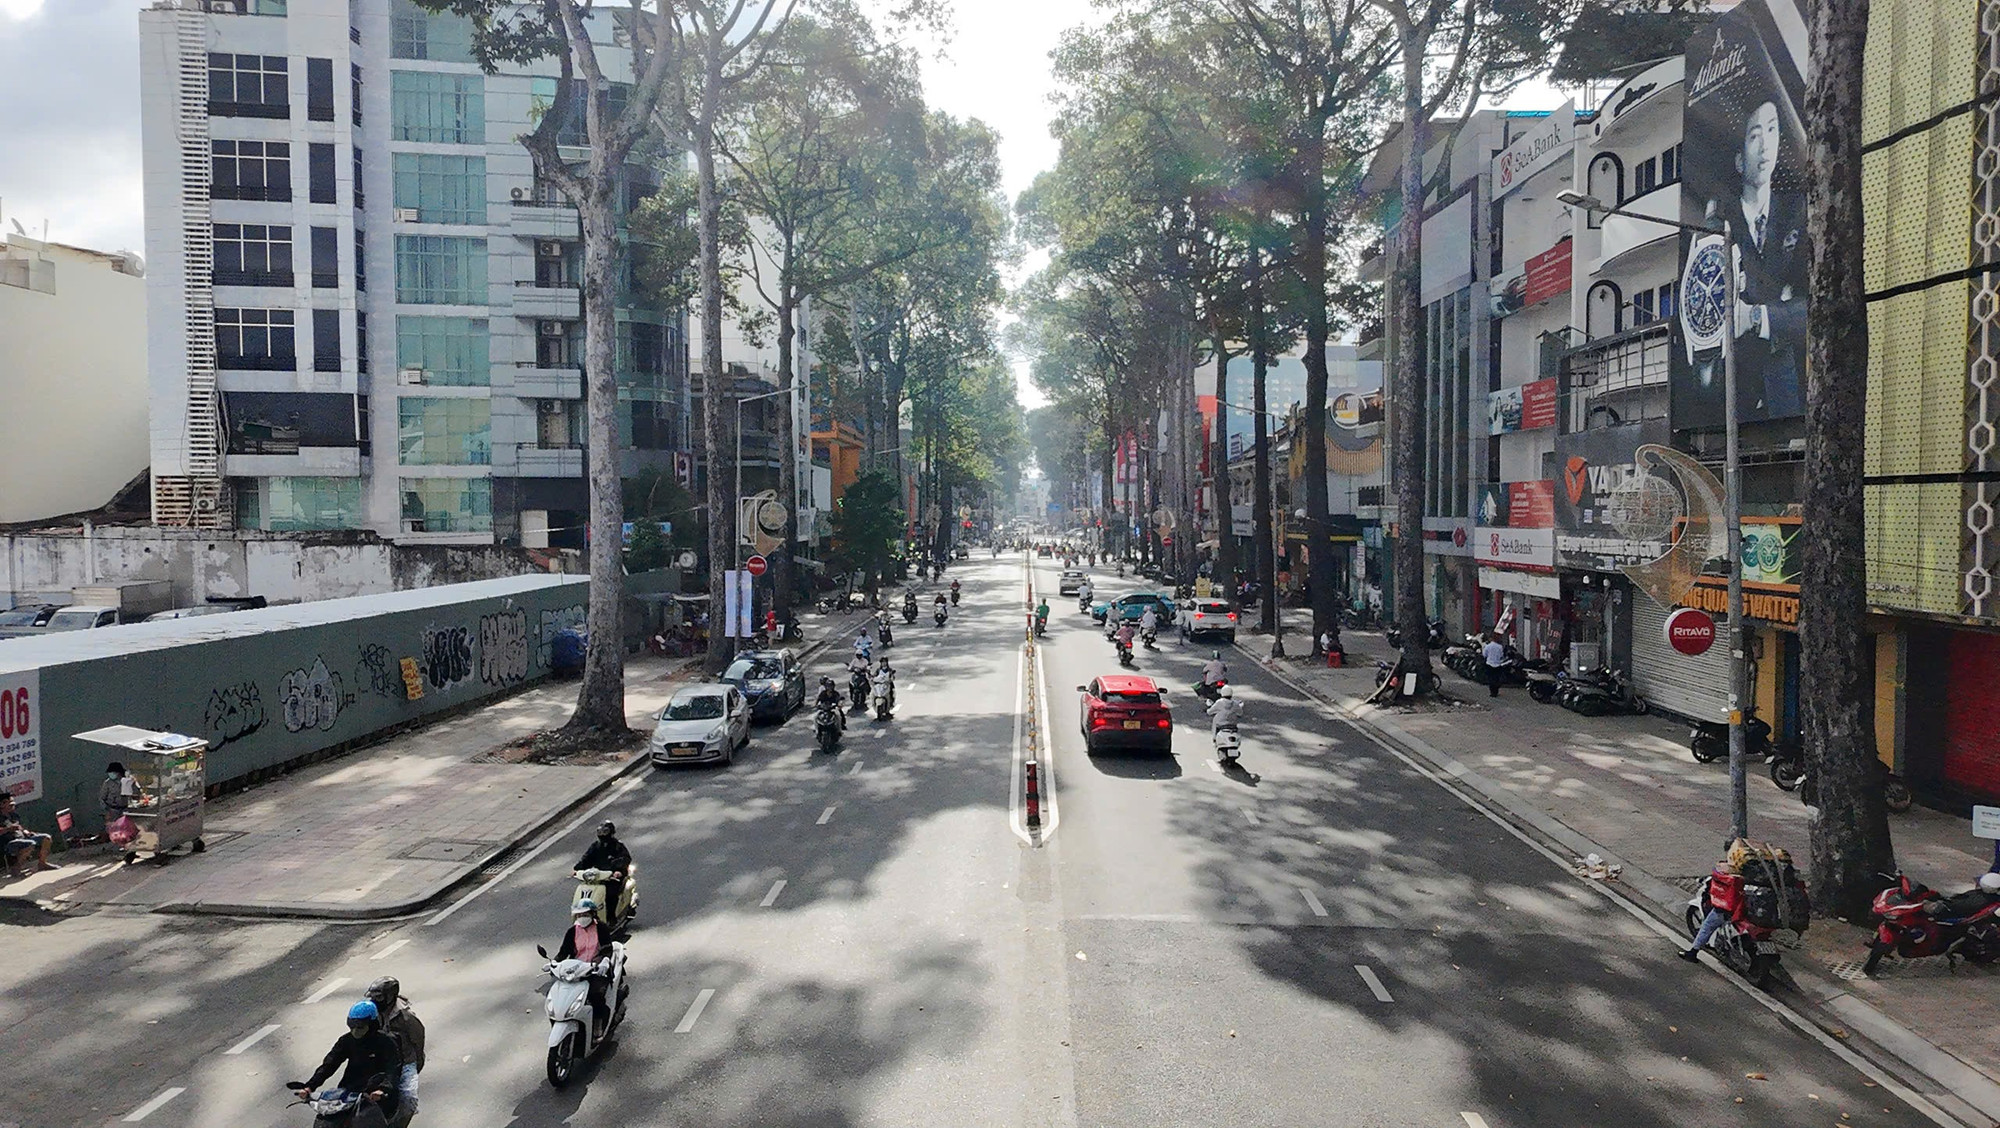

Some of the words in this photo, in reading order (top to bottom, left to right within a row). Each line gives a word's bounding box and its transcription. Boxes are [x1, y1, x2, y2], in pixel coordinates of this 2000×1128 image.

[1688, 44, 1747, 97] Atlantic
[1514, 123, 1562, 172] SeABank
[1501, 539, 1534, 555] SeABank
